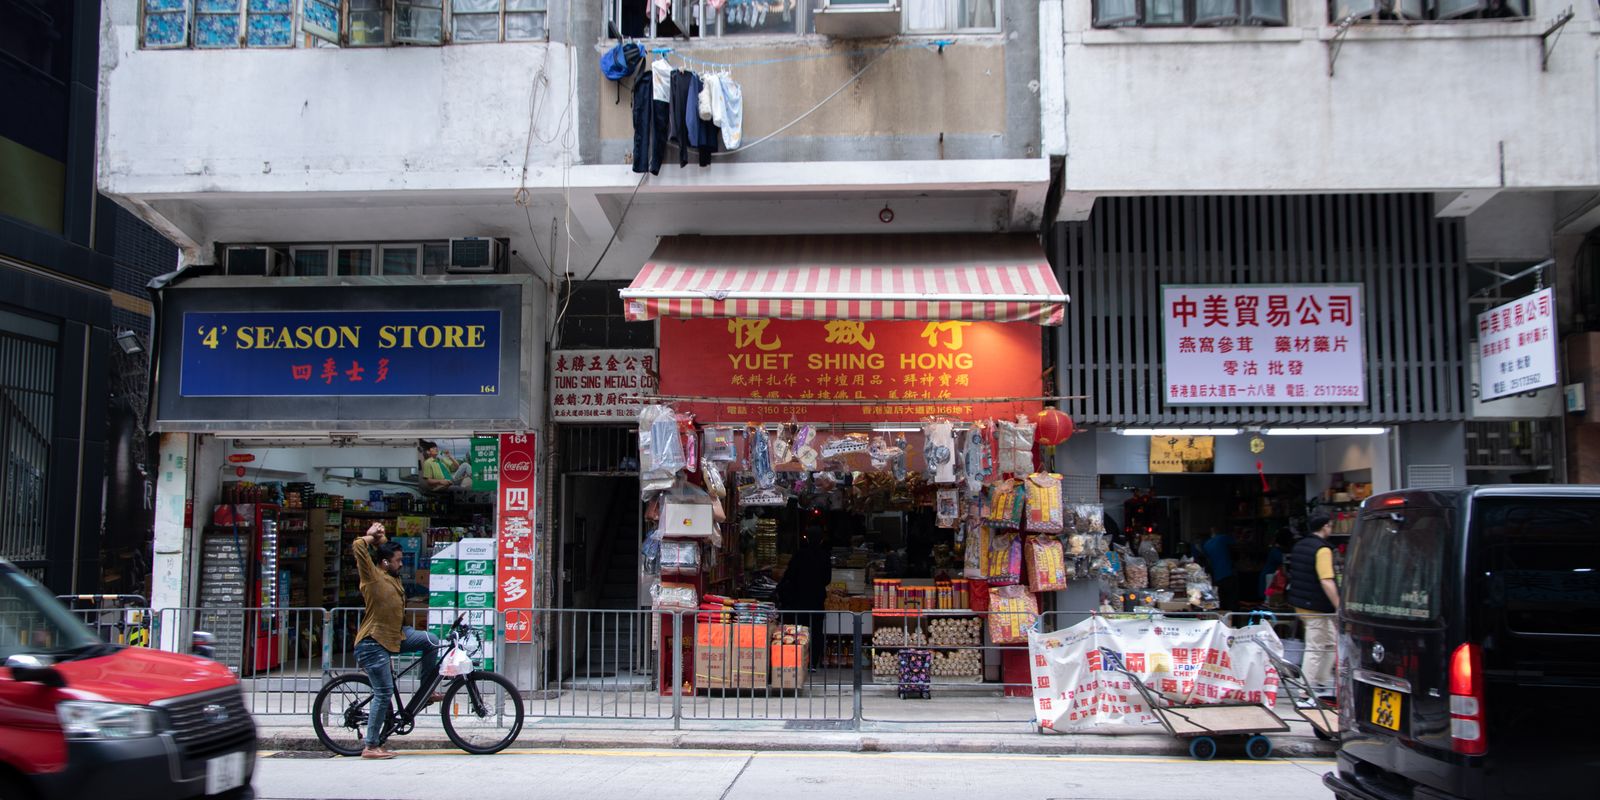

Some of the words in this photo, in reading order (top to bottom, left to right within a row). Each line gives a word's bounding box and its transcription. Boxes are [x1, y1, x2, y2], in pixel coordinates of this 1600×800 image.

[1172, 294, 1353, 328] 中美貿易公司
[235, 325, 362, 349] SEASON
[378, 324, 486, 349] STORE
[1179, 336, 1254, 353] 燕窩參茸
[1274, 335, 1348, 353] 藥材藥片
[291, 357, 390, 384] 四季士多
[555, 354, 653, 373] 東勝五金公司
[728, 353, 794, 370] YUET
[807, 353, 885, 370] SHING
[900, 353, 974, 370] HONG
[1223, 360, 1258, 375] 零沽
[1268, 360, 1304, 375] 批發
[479, 385, 496, 393] 164
[554, 375, 578, 389] TUNG
[580, 375, 601, 389] SING
[604, 375, 637, 389] METALS
[1170, 384, 1277, 398] 香港皇后大道西一六八號
[1313, 385, 1360, 397] 25173562
[509, 435, 528, 444] 164
[503, 487, 532, 603] 四季士多
[1376, 707, 1394, 728] 206
